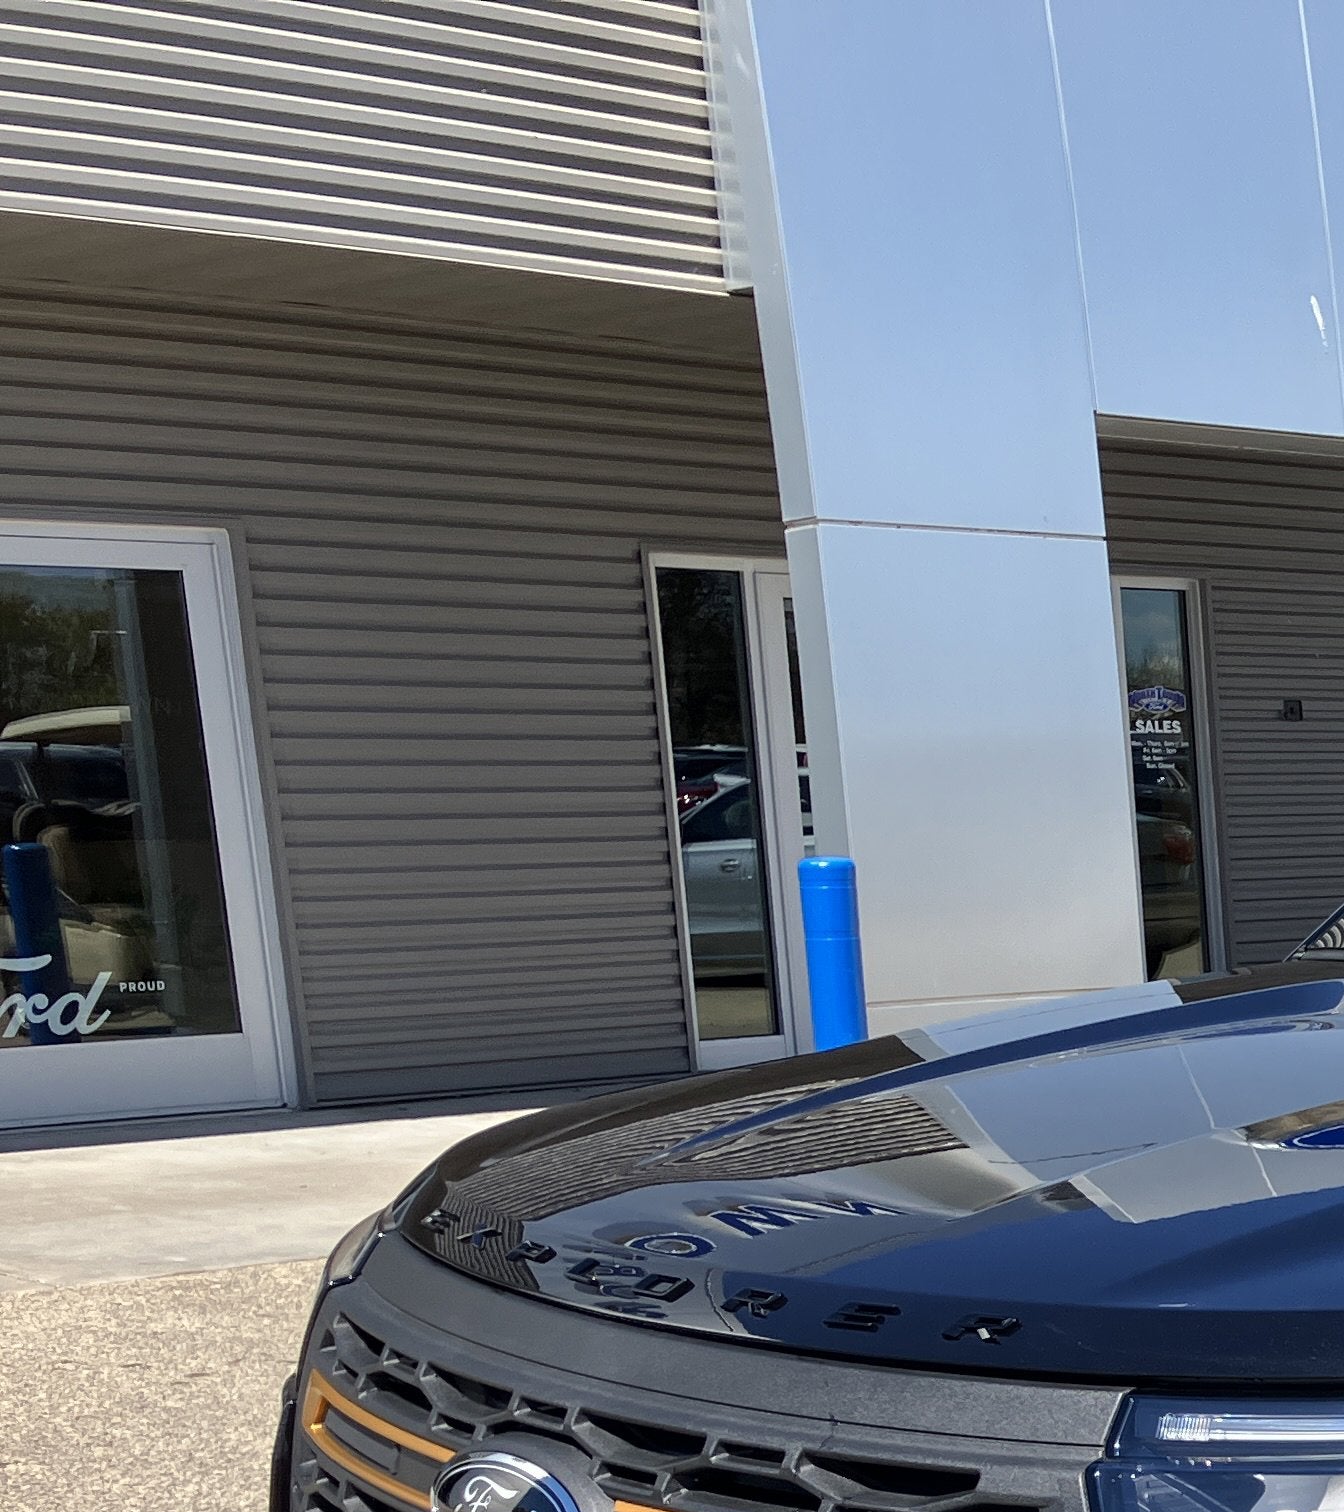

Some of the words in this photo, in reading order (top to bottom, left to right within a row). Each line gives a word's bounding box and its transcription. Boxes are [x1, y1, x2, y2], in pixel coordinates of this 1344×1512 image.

[1135, 720, 1182, 734] SALES
[119, 980, 166, 993] PROUD
[420, 1207, 1023, 1346] EXPLORER
